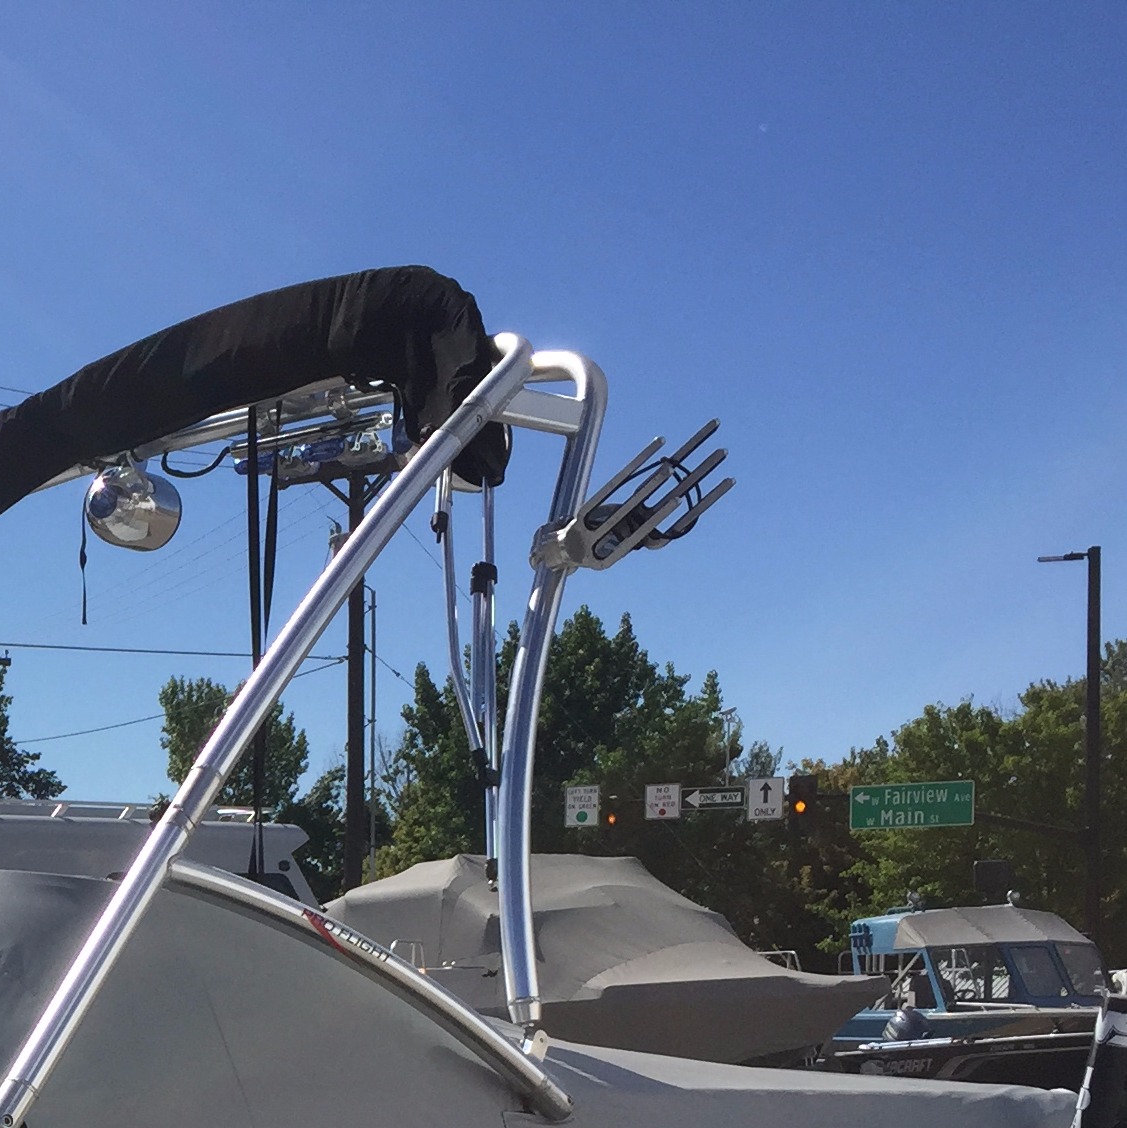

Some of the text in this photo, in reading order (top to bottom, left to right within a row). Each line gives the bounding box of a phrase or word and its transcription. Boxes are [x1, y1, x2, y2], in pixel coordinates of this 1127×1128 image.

[656, 786, 670, 794] NO
[699, 792, 739, 803] ONE WAY
[872, 797, 880, 806] W
[884, 786, 948, 805] Fairview
[754, 807, 776, 817] ONLY
[866, 818, 875, 826] W
[880, 807, 925, 826] Main
[301, 908, 394, 963] PRO FLIGHT
